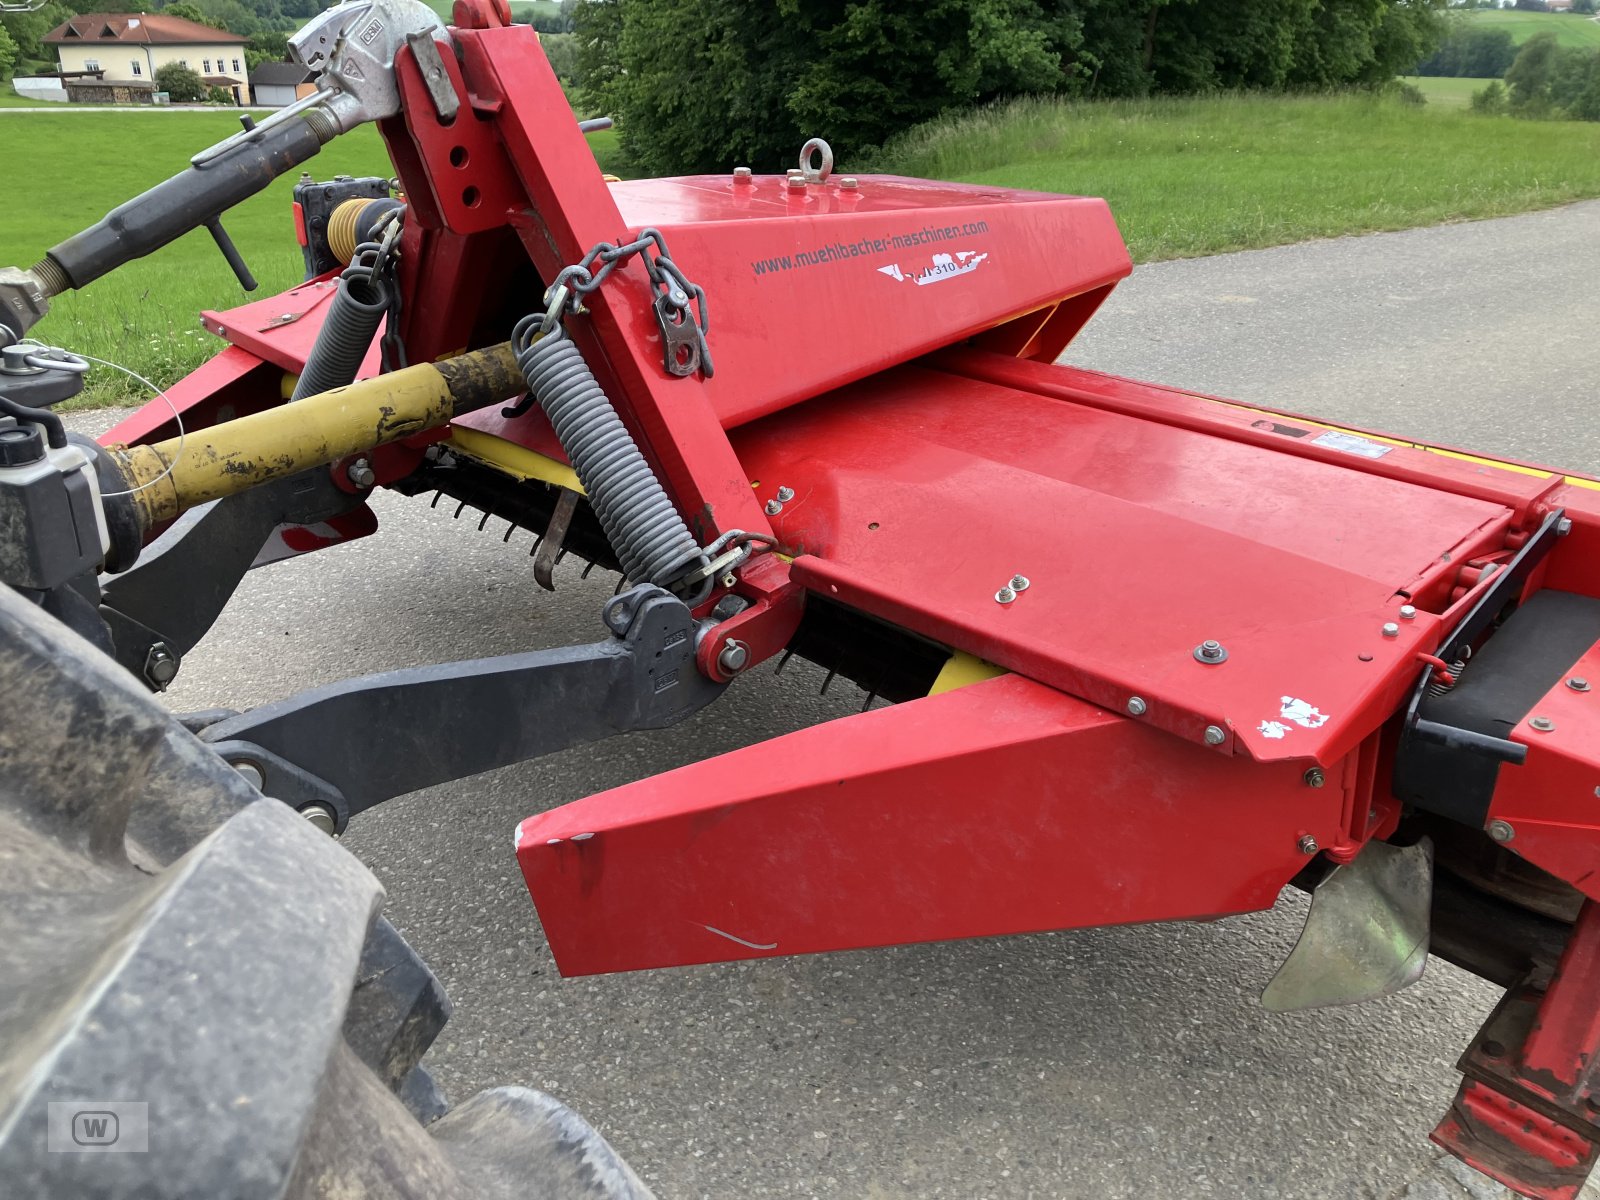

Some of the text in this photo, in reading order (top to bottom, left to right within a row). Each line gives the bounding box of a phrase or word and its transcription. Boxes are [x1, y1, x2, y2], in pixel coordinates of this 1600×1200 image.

[363, 21, 382, 42] CBM
[751, 220, 989, 276] www.muehlbacher-maschinen.com
[934, 262, 956, 275] 310
